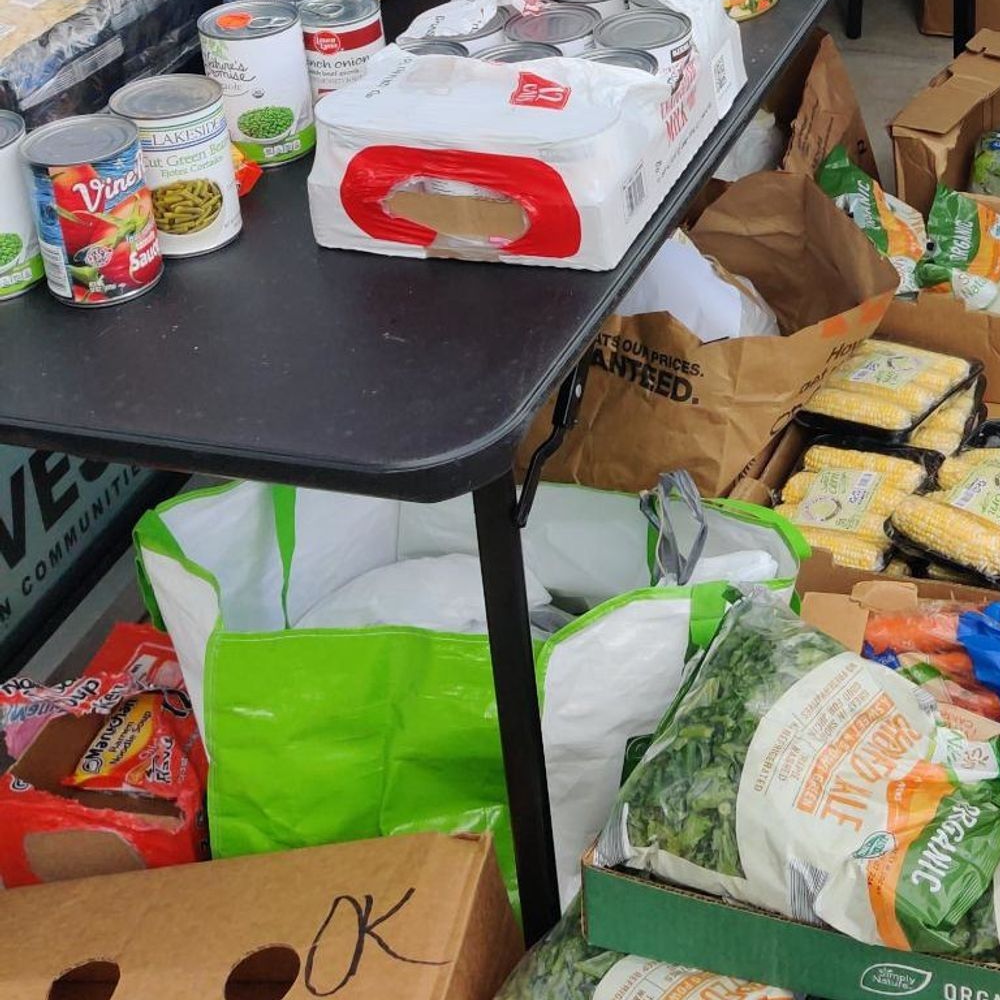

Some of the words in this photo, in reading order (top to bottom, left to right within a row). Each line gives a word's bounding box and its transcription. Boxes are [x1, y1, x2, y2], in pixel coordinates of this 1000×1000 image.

[167, 148, 207, 168] Green
[621, 339, 651, 361] OUR
[651, 351, 704, 378] PRICES.
[21, 462, 141, 596] COMMUNITIE
[85, 699, 138, 759] Maruchan
[304, 887, 451, 998] OK
[873, 975, 912, 990] Nature
[879, 967, 916, 985] Simply
